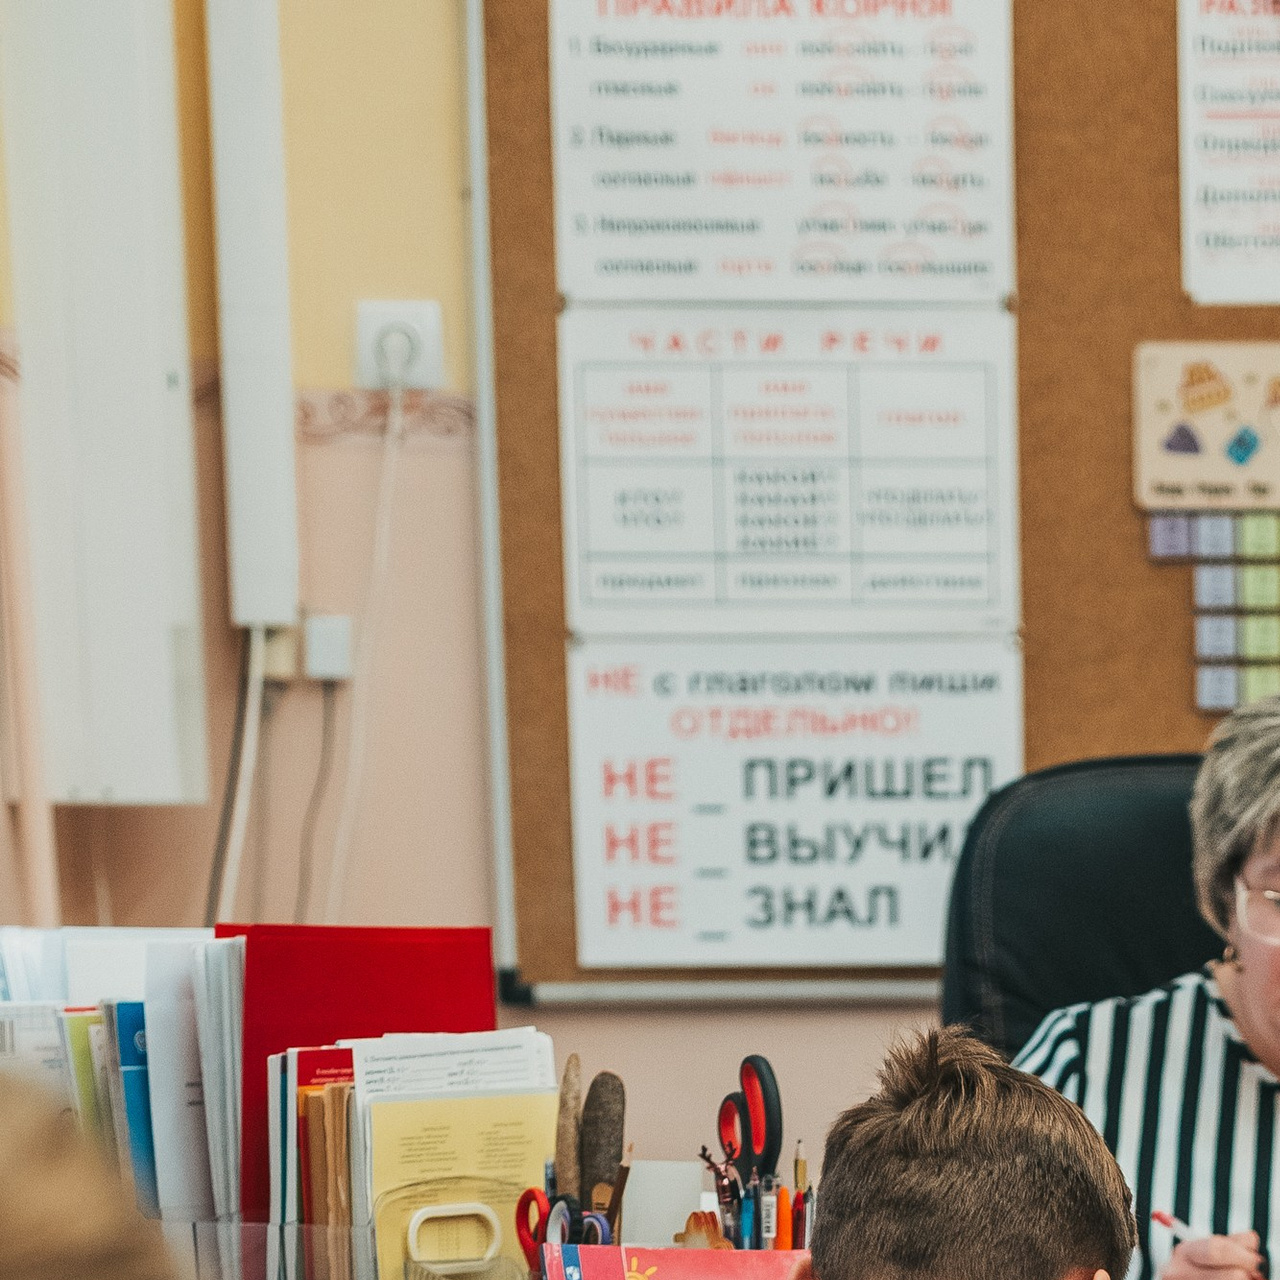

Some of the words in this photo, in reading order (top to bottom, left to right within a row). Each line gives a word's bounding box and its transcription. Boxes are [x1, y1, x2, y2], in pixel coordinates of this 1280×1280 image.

[629, 331, 786, 355] ЧАСТИ
[819, 331, 946, 355] РЕЧИ
[586, 664, 641, 696] НЕ
[653, 673, 677, 697] с
[687, 671, 878, 697] глаголом
[888, 670, 1001, 695] пиши
[669, 705, 921, 741] ОТДЕЛЬНО!
[601, 757, 677, 801] НЕ
[742, 757, 993, 801] ПРИШЕЛ
[604, 821, 679, 866] НЕ
[744, 821, 955, 868] ВЫУЧИ
[606, 885, 680, 929] НЕ
[744, 885, 903, 929] ЗНАЛ
